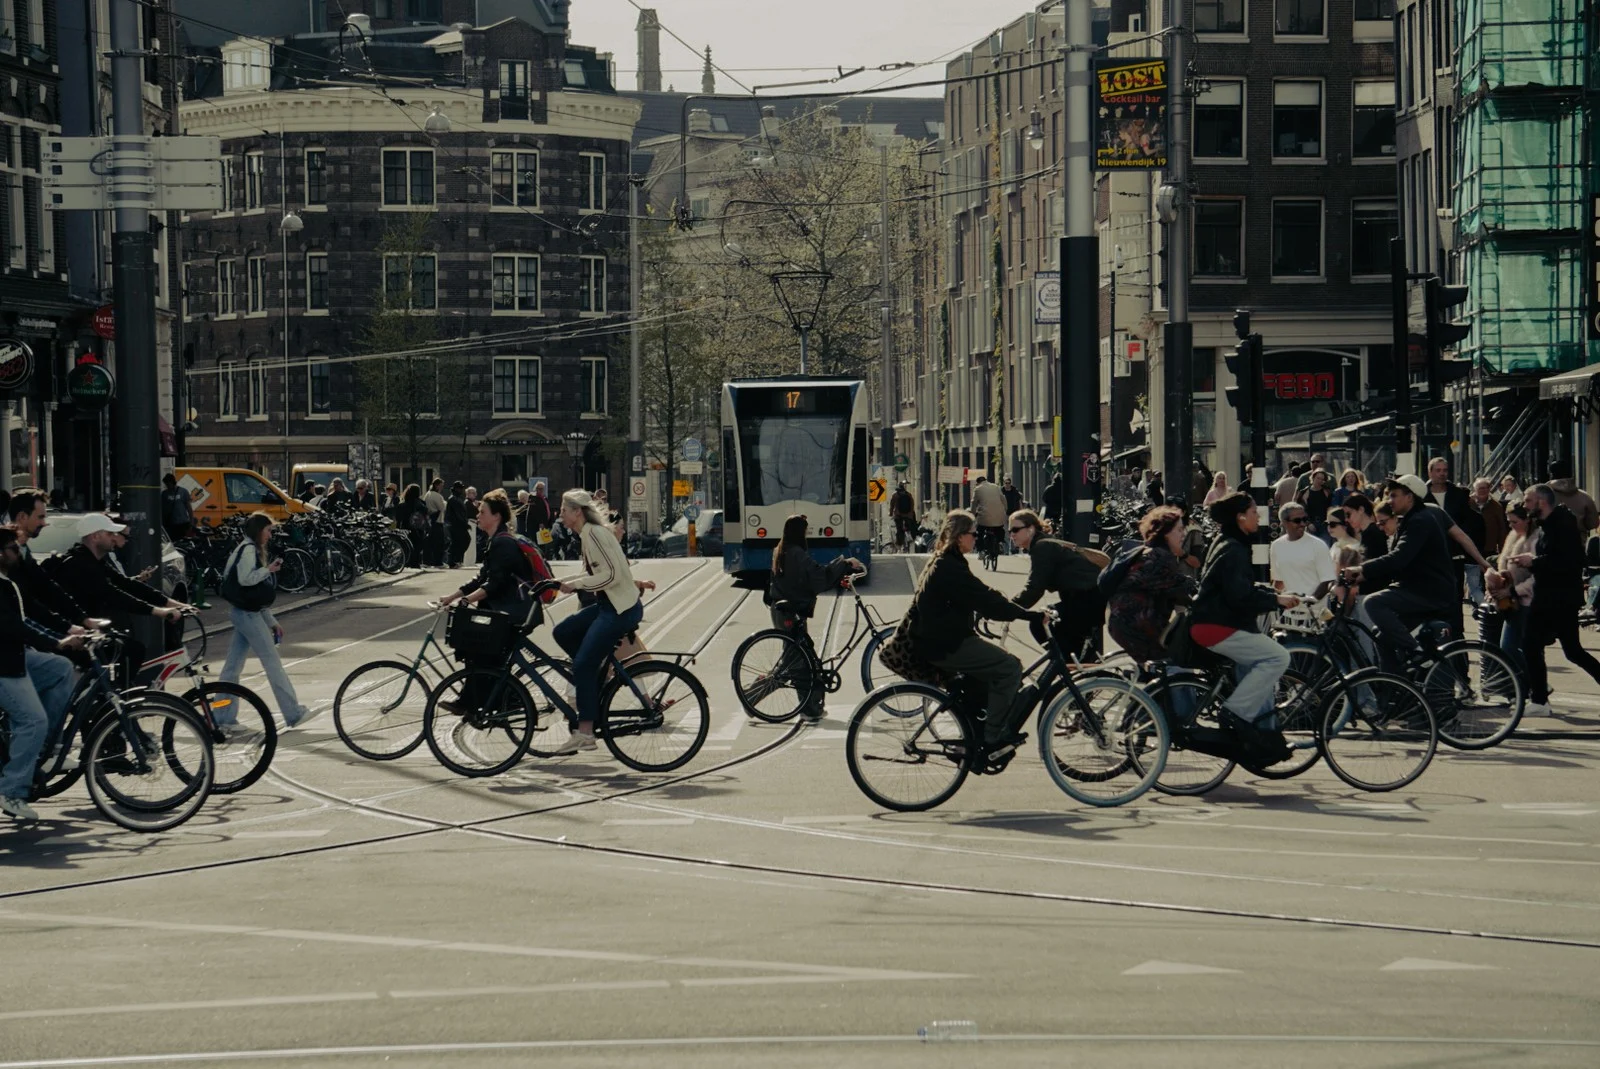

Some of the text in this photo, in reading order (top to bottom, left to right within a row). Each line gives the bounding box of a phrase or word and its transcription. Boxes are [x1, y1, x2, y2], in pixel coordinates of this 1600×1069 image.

[1098, 65, 1166, 94] LOST
[1103, 95, 1161, 104] Cocktail bar
[1098, 158, 1167, 168] Nieuwendijk 19
[72, 386, 107, 396] Heineken
[1263, 372, 1335, 399] FEBO
[786, 391, 801, 409] 17
